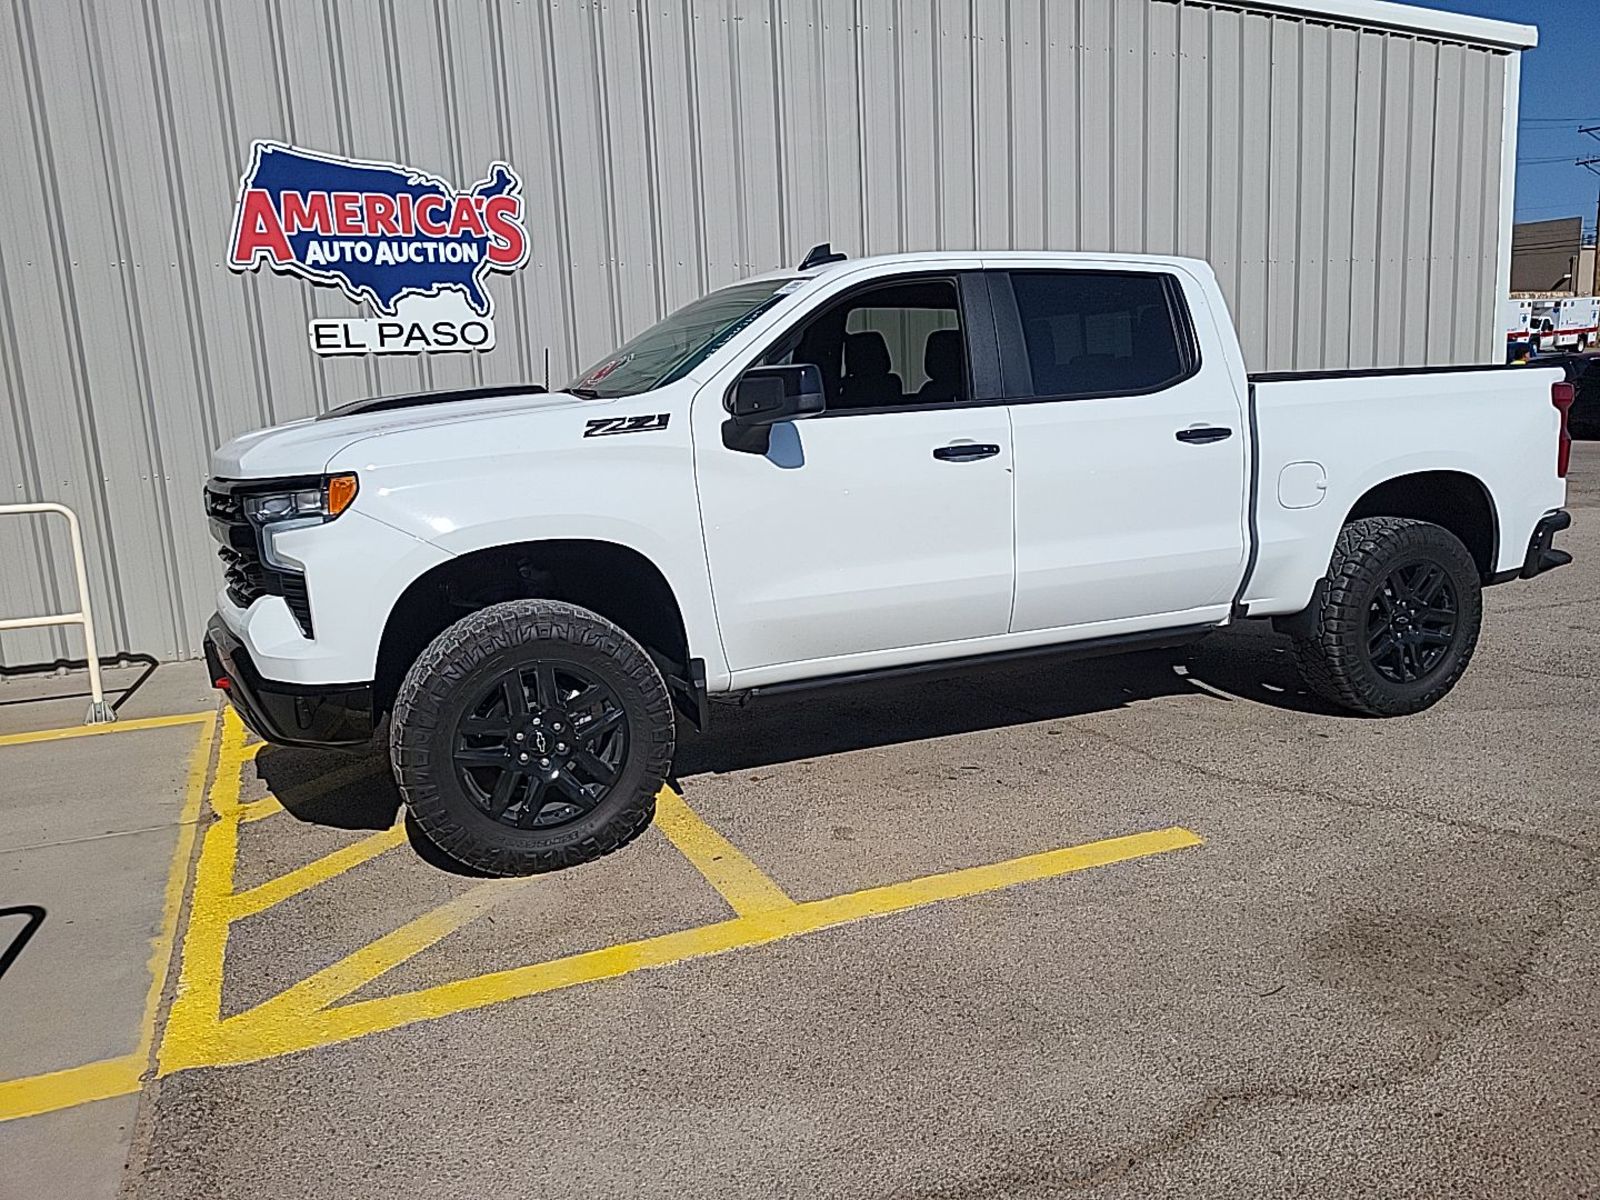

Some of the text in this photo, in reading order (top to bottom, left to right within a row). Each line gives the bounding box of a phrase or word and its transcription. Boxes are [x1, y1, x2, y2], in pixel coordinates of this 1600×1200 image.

[235, 190, 524, 263] AMERICA'S
[305, 240, 479, 266] AUTO AUCTION
[313, 320, 490, 349] EL PASO
